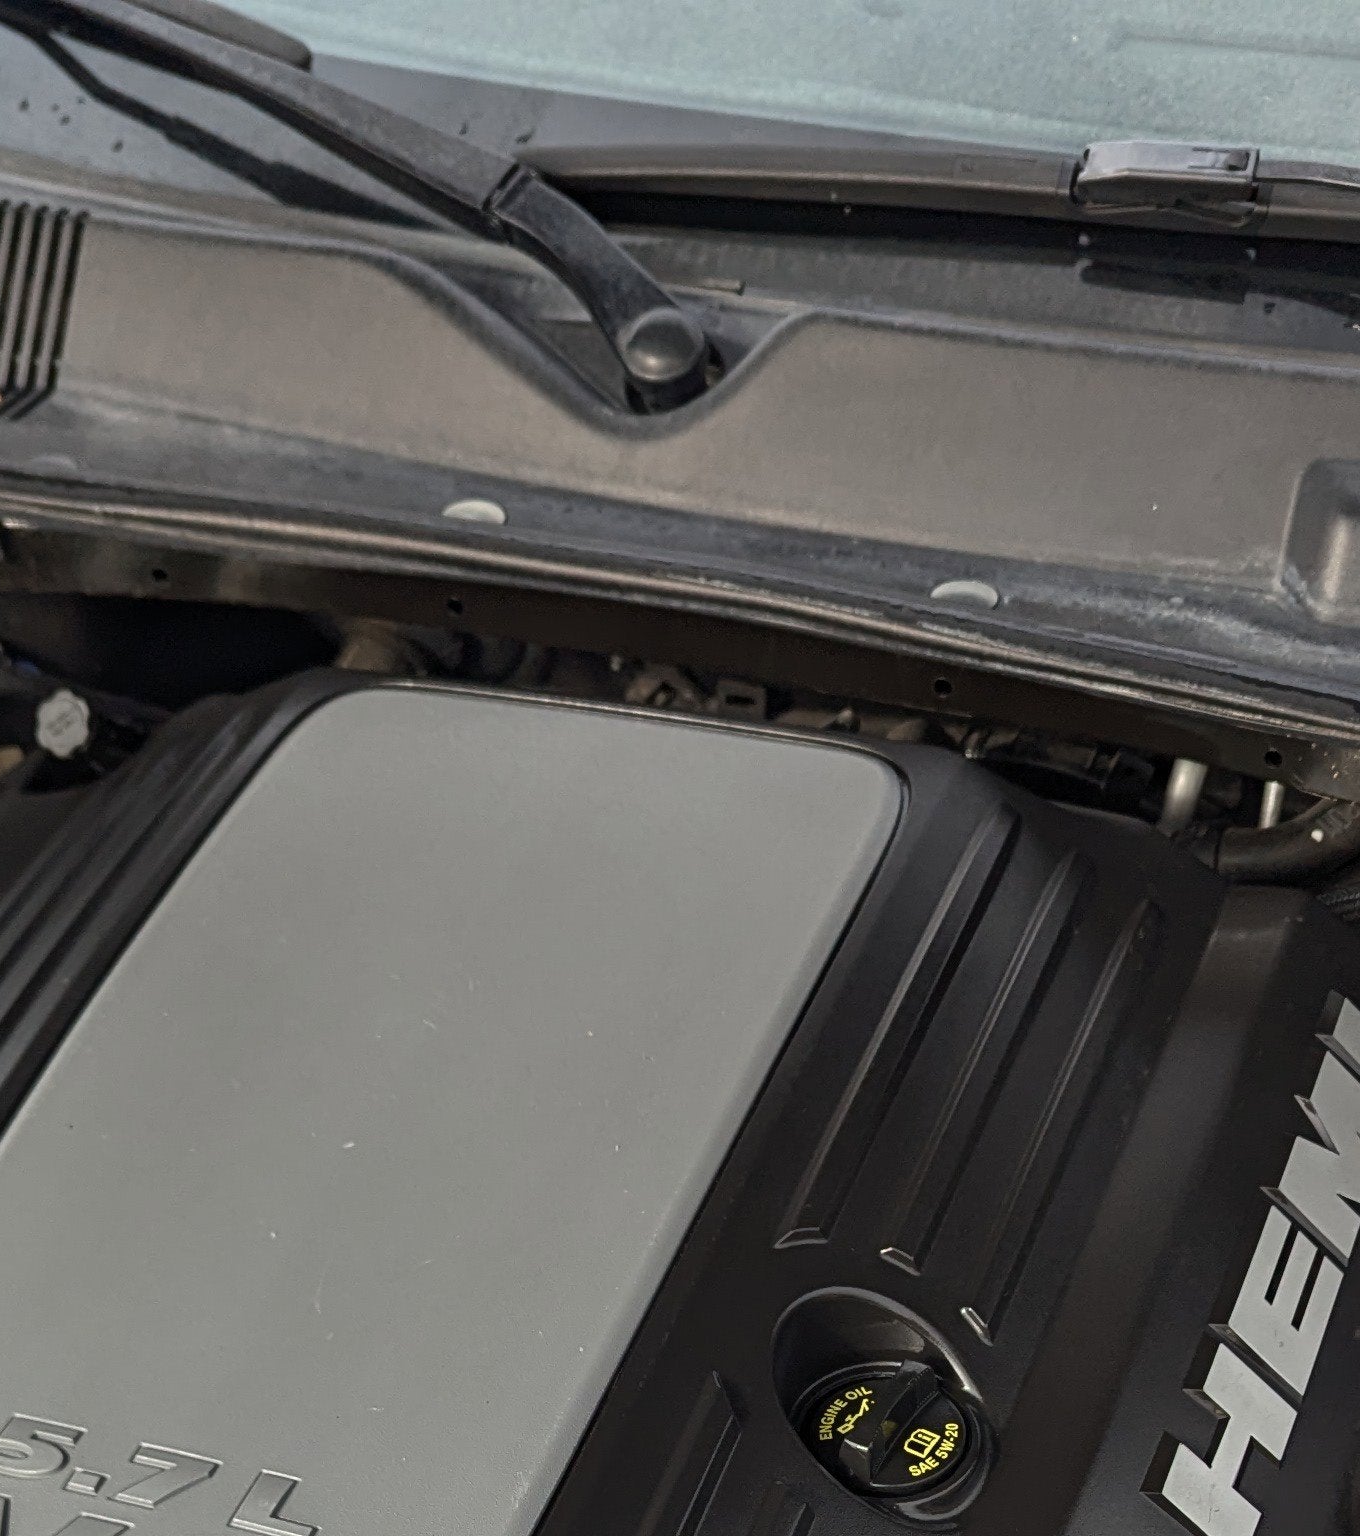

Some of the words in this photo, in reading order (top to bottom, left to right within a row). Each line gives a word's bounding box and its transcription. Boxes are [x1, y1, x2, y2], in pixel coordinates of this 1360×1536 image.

[819, 1397, 848, 1441] ENGINE
[845, 1386, 873, 1403] OIL
[908, 1456, 940, 1477] SAE
[935, 1423, 960, 1459] 5W-20
